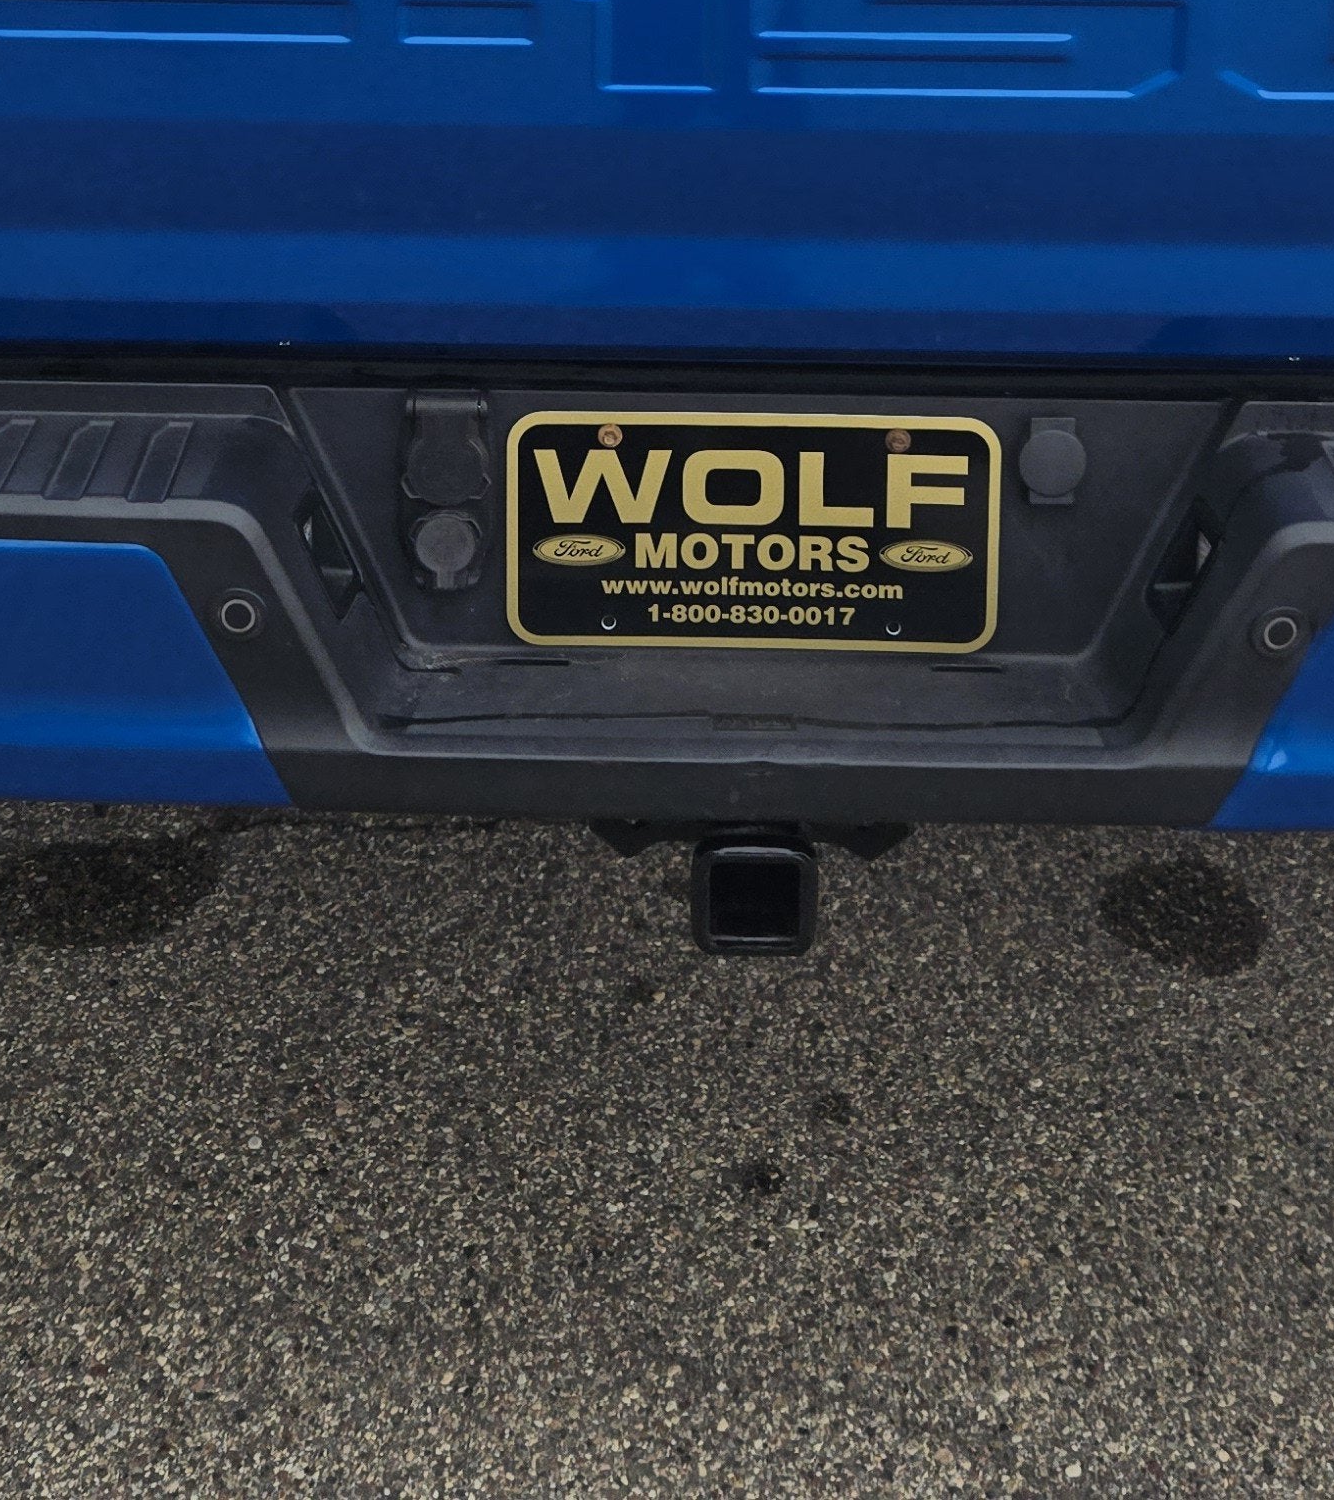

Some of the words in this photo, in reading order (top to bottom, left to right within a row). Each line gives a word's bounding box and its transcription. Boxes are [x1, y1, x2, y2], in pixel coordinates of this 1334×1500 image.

[533, 449, 969, 528] WOLF
[635, 533, 870, 572] MOTORS
[602, 577, 903, 599] www.wolfmotors.com
[648, 604, 855, 625] 1-800-830-0017
